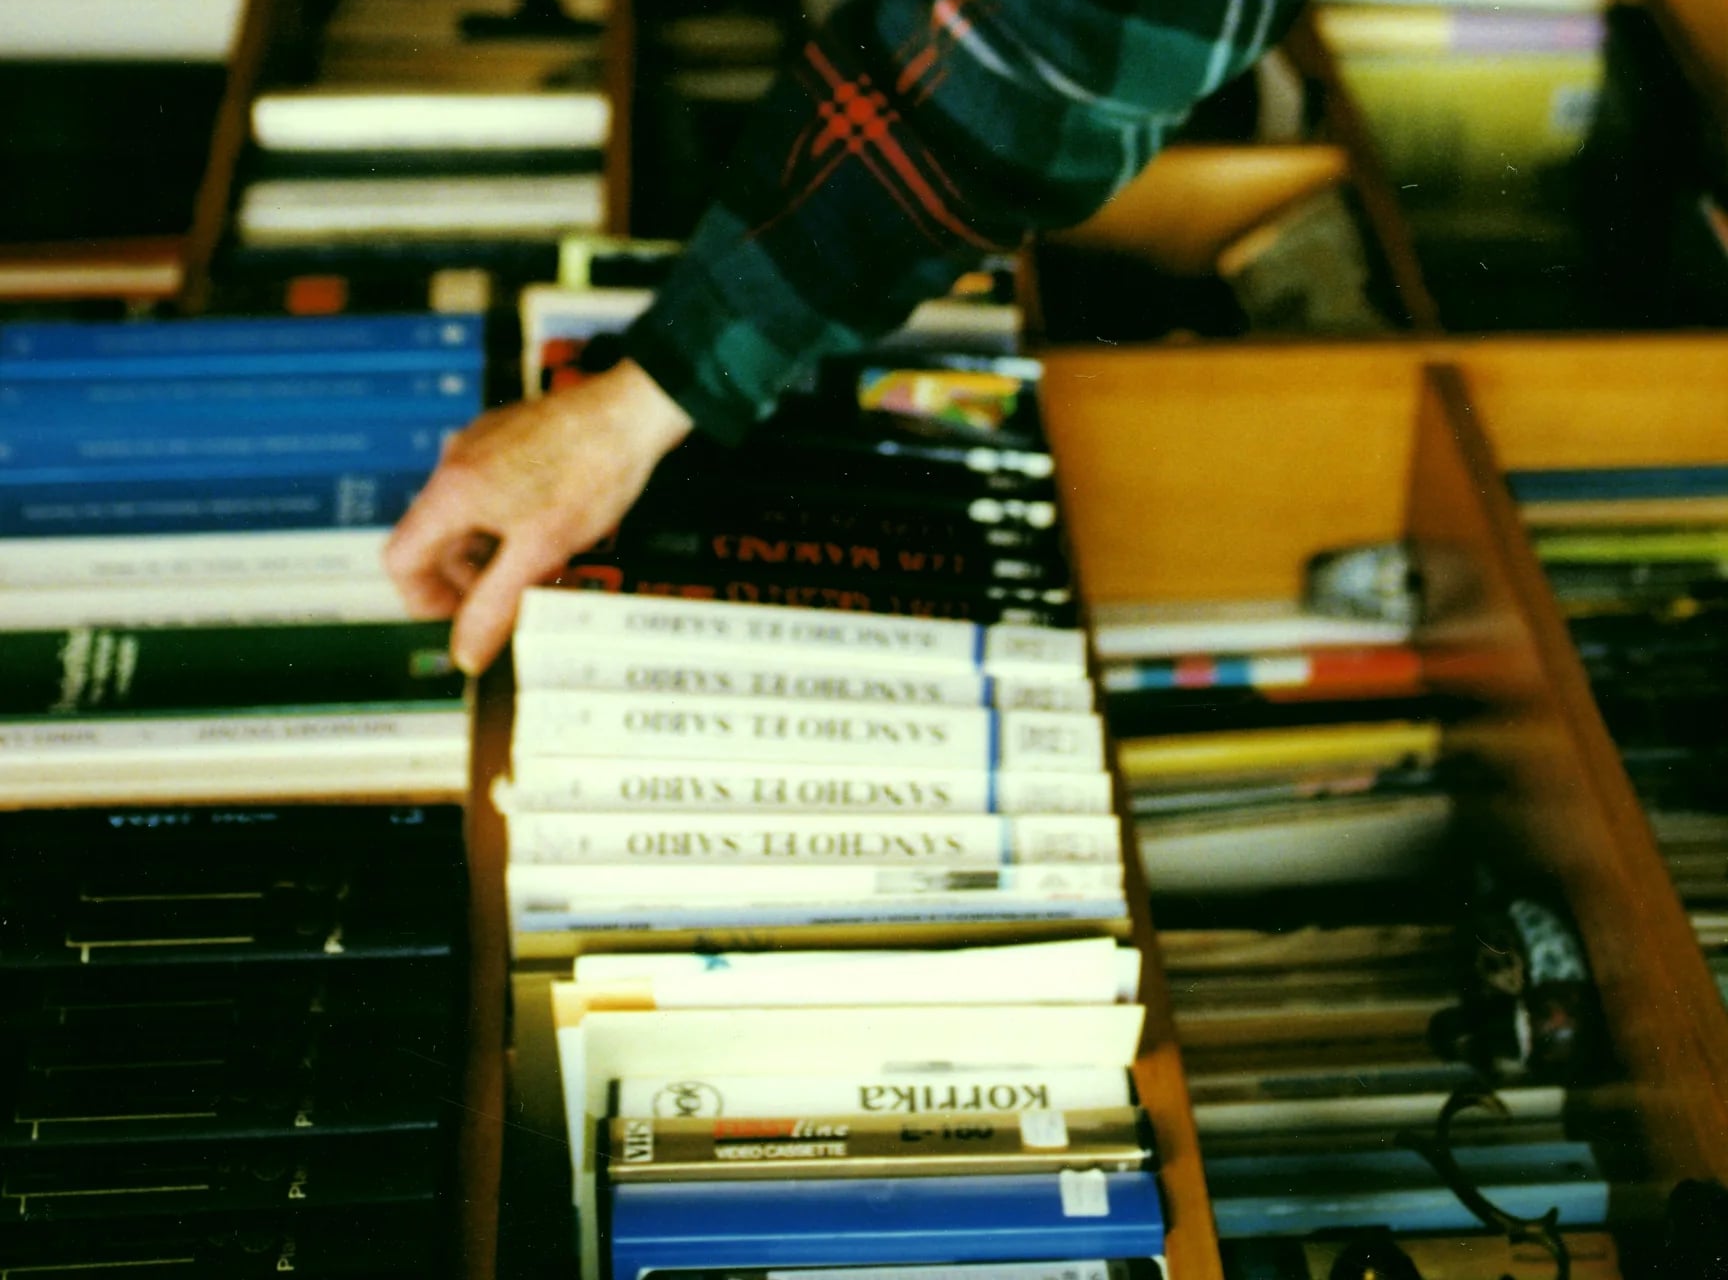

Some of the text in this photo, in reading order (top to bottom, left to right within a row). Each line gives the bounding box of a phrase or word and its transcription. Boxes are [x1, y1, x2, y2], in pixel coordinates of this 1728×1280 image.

[620, 775, 952, 807] SANCHO EL SABIO
[627, 831, 965, 857] SANCHO EL SABIO
[626, 1122, 649, 1160] VHS
